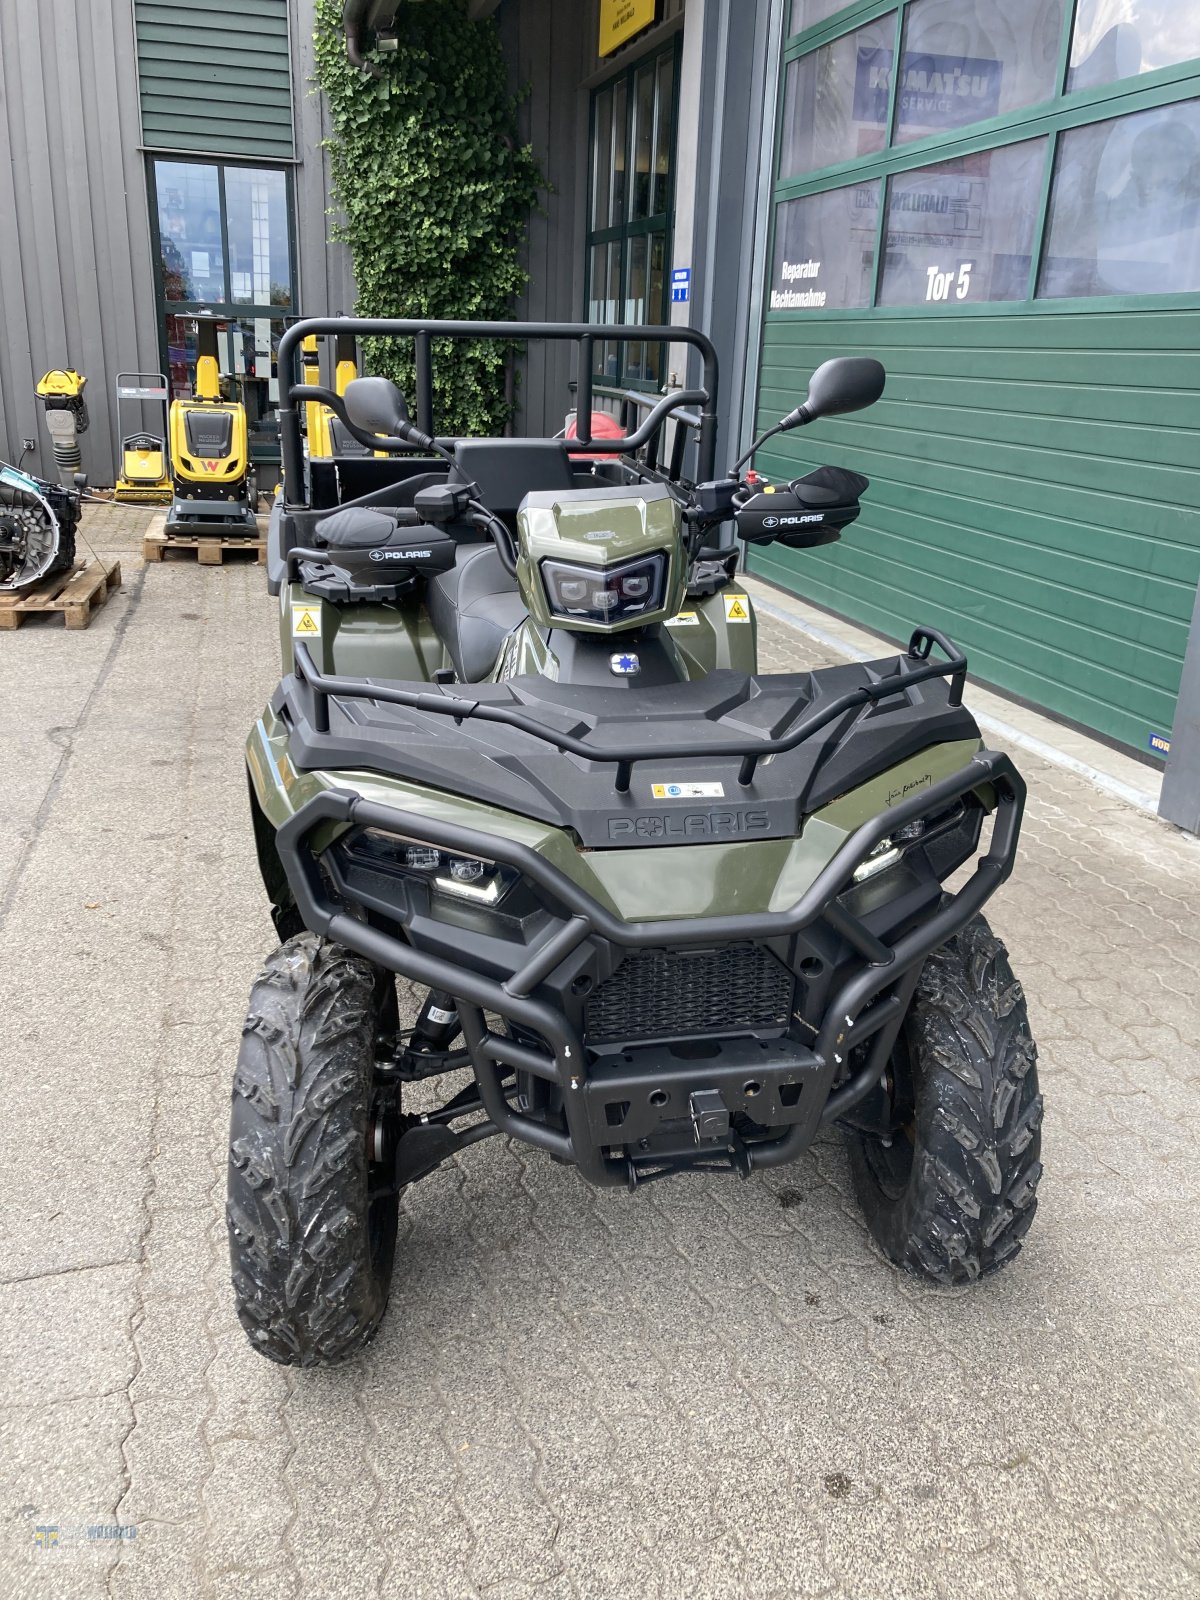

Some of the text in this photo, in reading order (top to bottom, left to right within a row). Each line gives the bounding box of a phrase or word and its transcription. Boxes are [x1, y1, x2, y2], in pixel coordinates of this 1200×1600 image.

[902, 96, 953, 112] SERVICE
[781, 260, 821, 283] Reparatur
[926, 263, 971, 301] Tor 5
[770, 288, 827, 309] Nachtannahme
[779, 514, 825, 525] POLARIS
[384, 550, 432, 560] POLARIS
[606, 810, 772, 840] POLARIS
